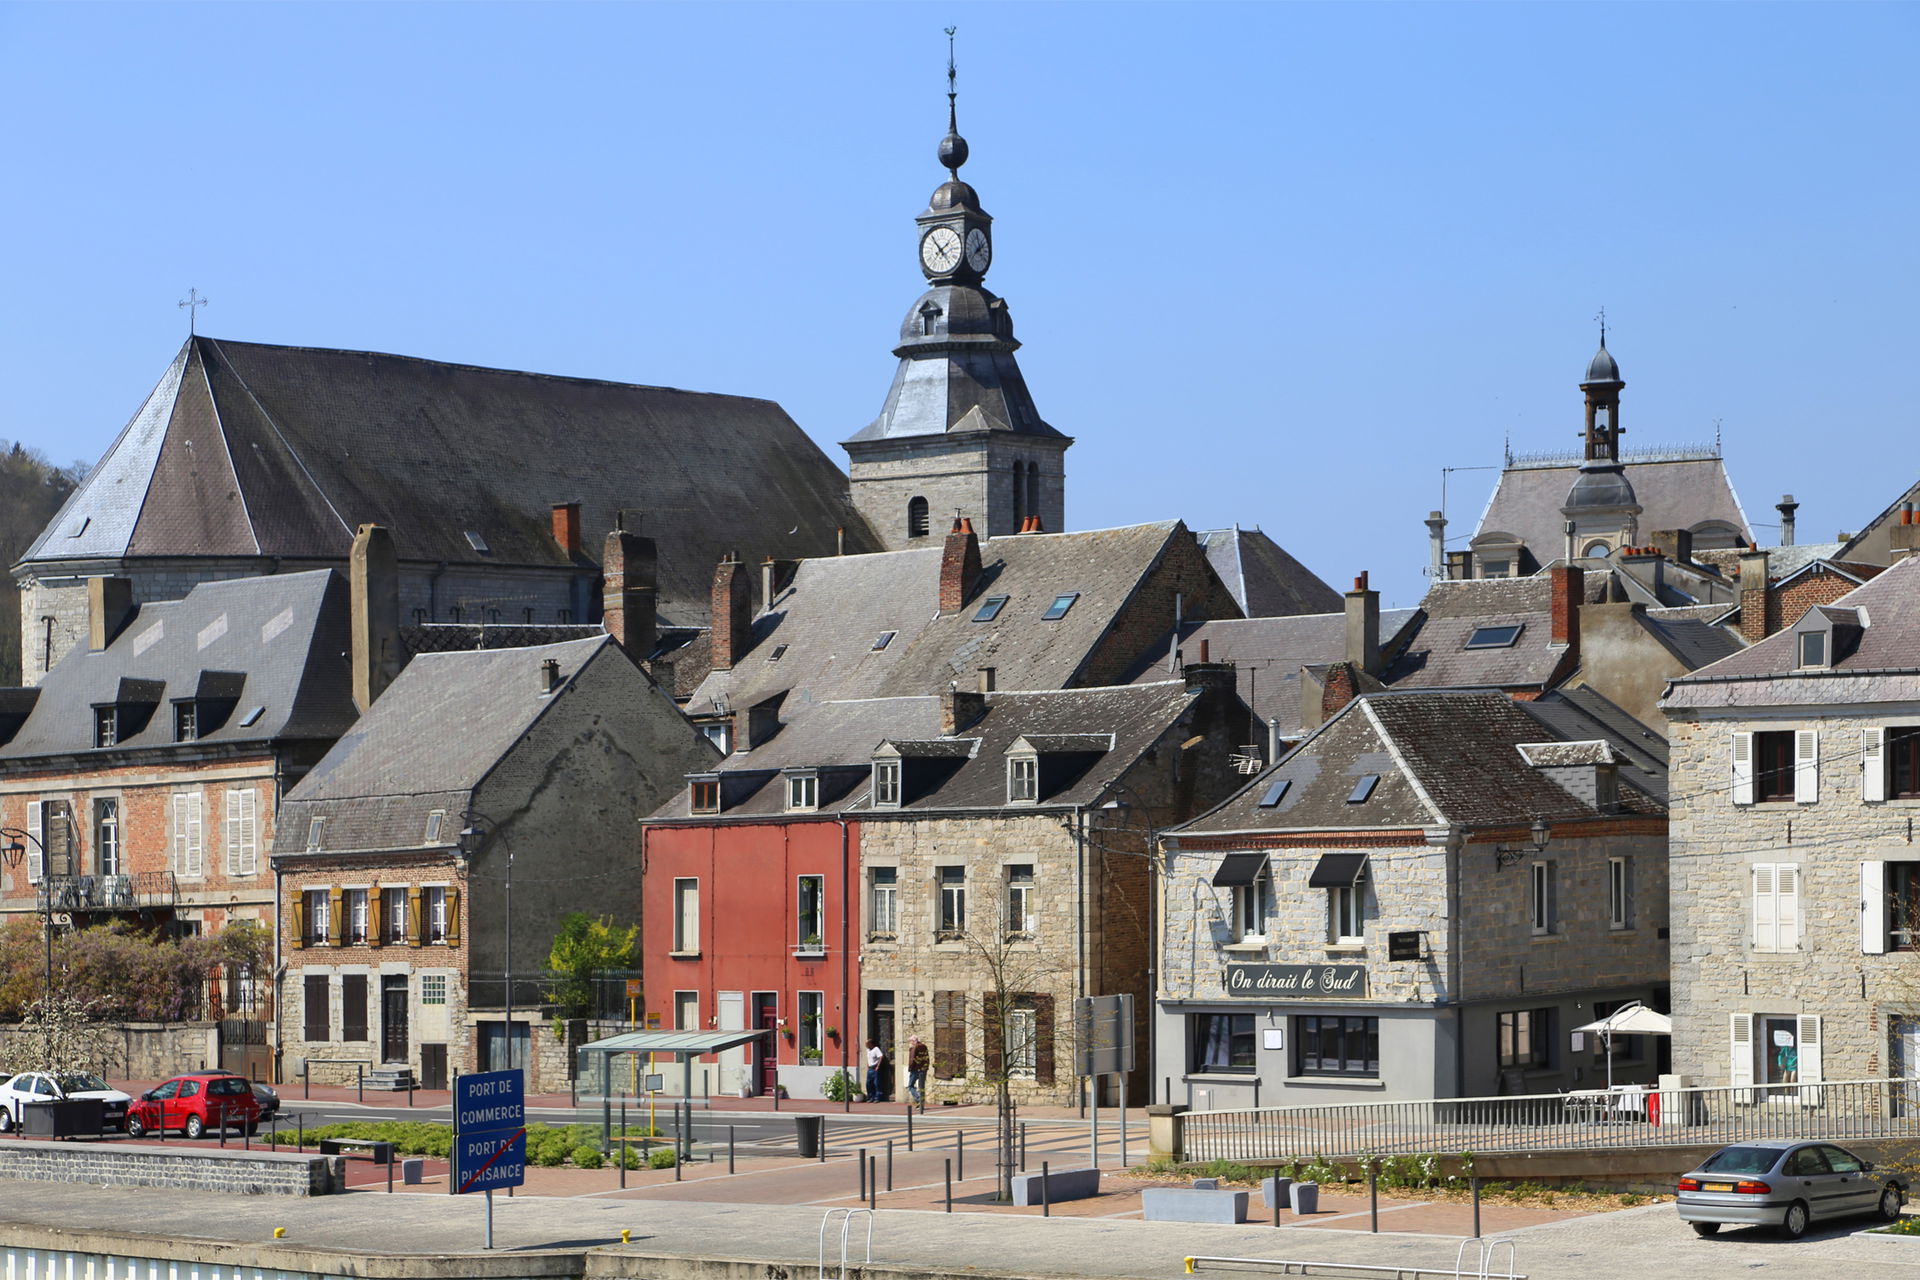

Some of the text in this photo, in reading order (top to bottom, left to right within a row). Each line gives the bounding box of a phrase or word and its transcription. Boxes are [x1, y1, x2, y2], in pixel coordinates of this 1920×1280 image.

[1231, 966, 1359, 994] On dirait le Sud
[469, 1080, 512, 1098] PORT DE
[461, 1105, 521, 1124] COMMERCE
[468, 1140, 496, 1157] PORT
